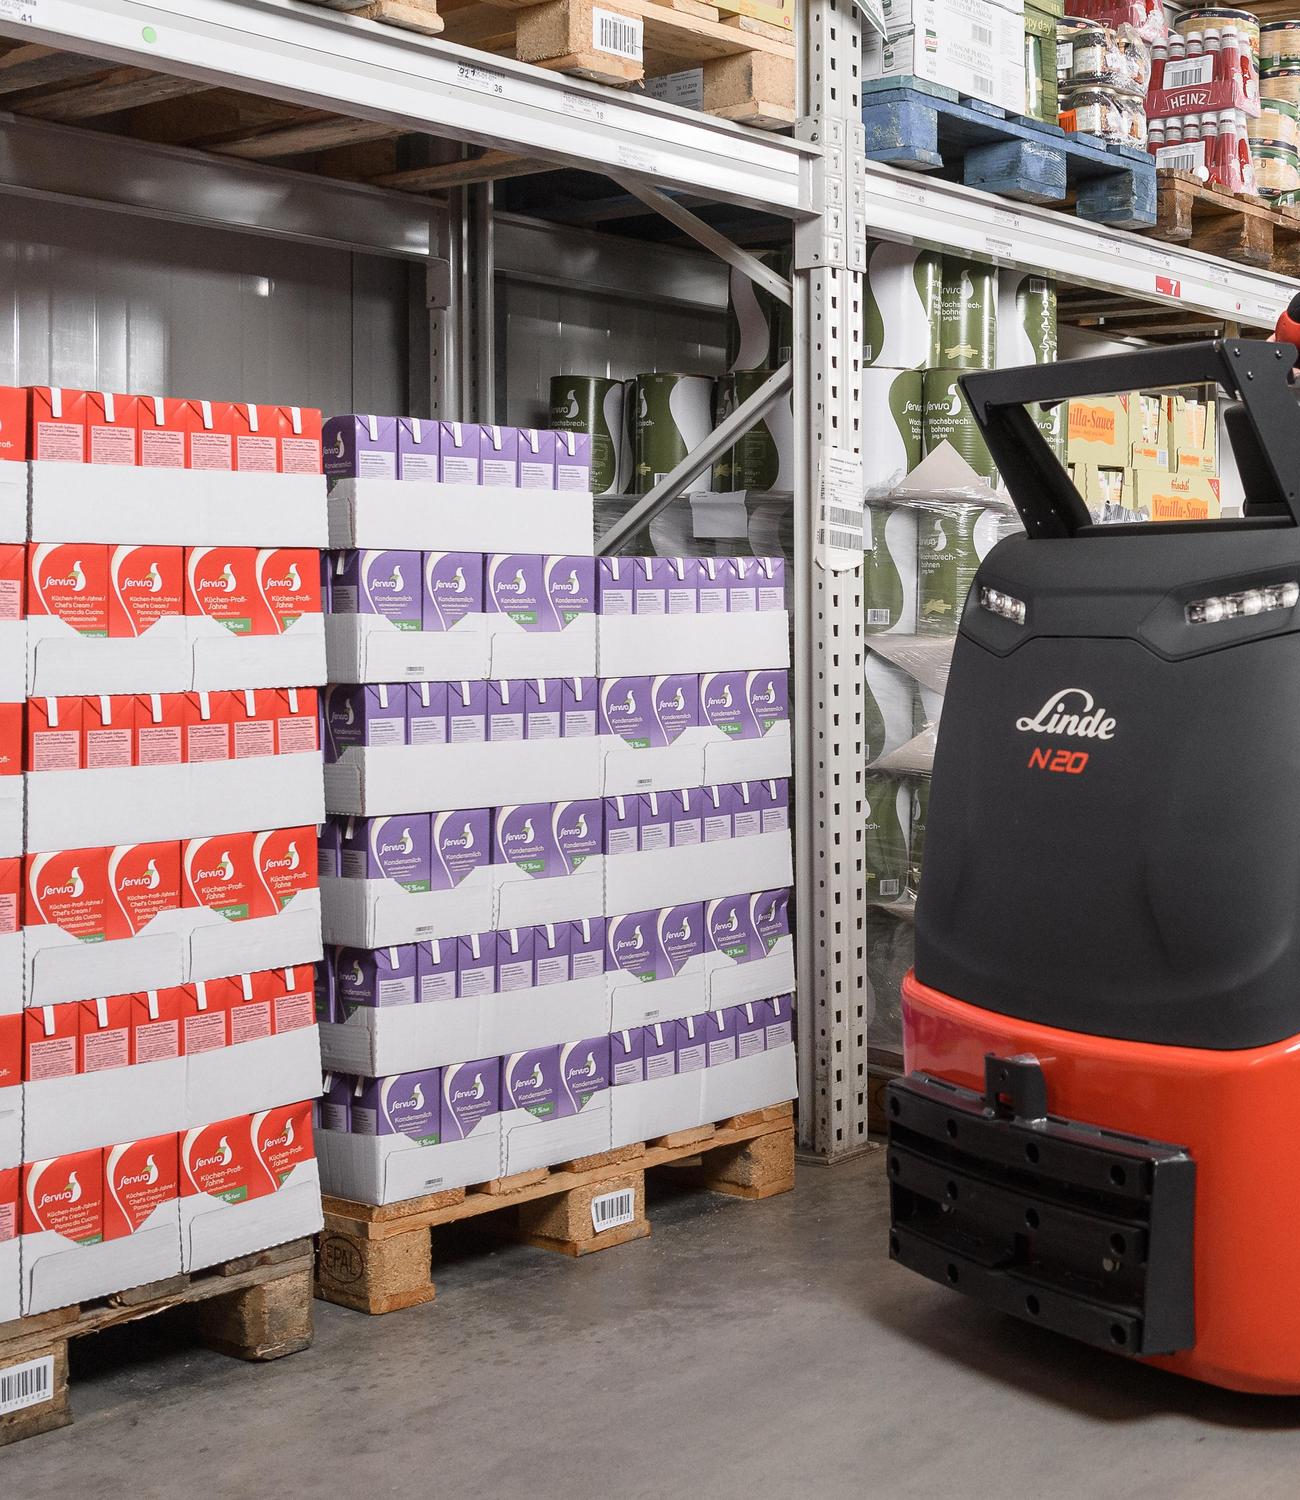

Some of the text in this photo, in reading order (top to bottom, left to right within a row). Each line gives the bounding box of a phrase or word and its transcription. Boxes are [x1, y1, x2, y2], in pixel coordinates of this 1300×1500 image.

[494, 84, 503, 93] 36
[1170, 93, 1207, 109] HEINZ
[1169, 281, 1177, 296] 7
[1070, 408, 1114, 430] illa-Sauce
[1154, 501, 1208, 520] Vanilla-Sauce
[42, 576, 76, 590] Servisa
[121, 577, 153, 591] Servisa
[197, 578, 226, 591] Servisa
[265, 578, 292, 591] Servisa
[1016, 688, 1117, 740] Linde
[263, 859, 291, 872] Servisa
[119, 877, 150, 891] Servisa
[194, 869, 224, 884] Servisa
[40, 885, 74, 900] Servisa
[193, 1156, 223, 1172] Servisa
[117, 1175, 149, 1190] Servisa
[38, 1191, 71, 1209] Servisa
